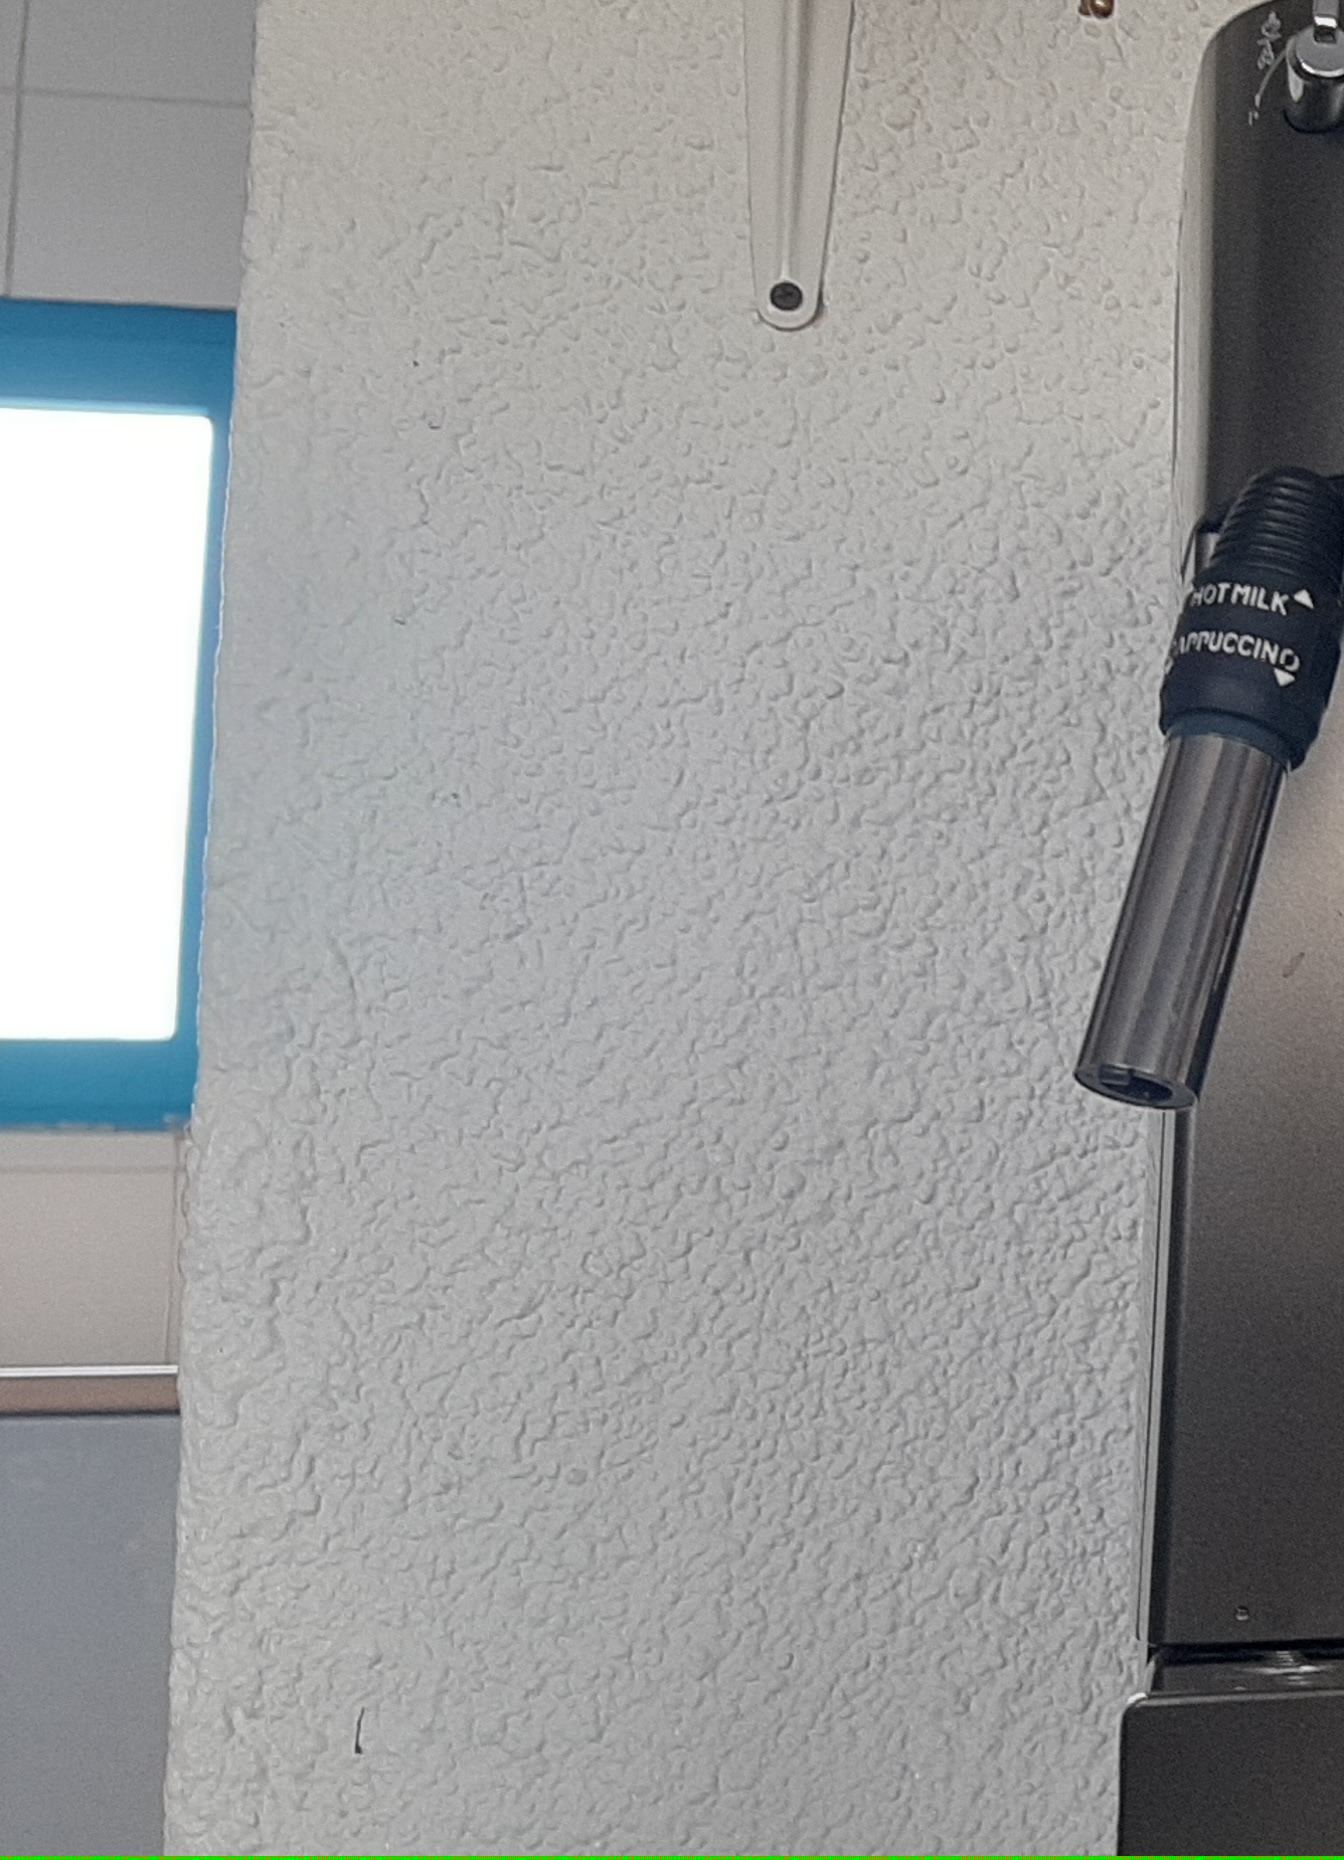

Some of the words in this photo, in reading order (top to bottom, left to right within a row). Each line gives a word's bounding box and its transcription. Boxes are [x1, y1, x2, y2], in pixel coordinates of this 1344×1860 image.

[1190, 582, 1231, 607] HOT
[1230, 583, 1289, 616] MILK
[1176, 630, 1300, 672] APPUCCINO
